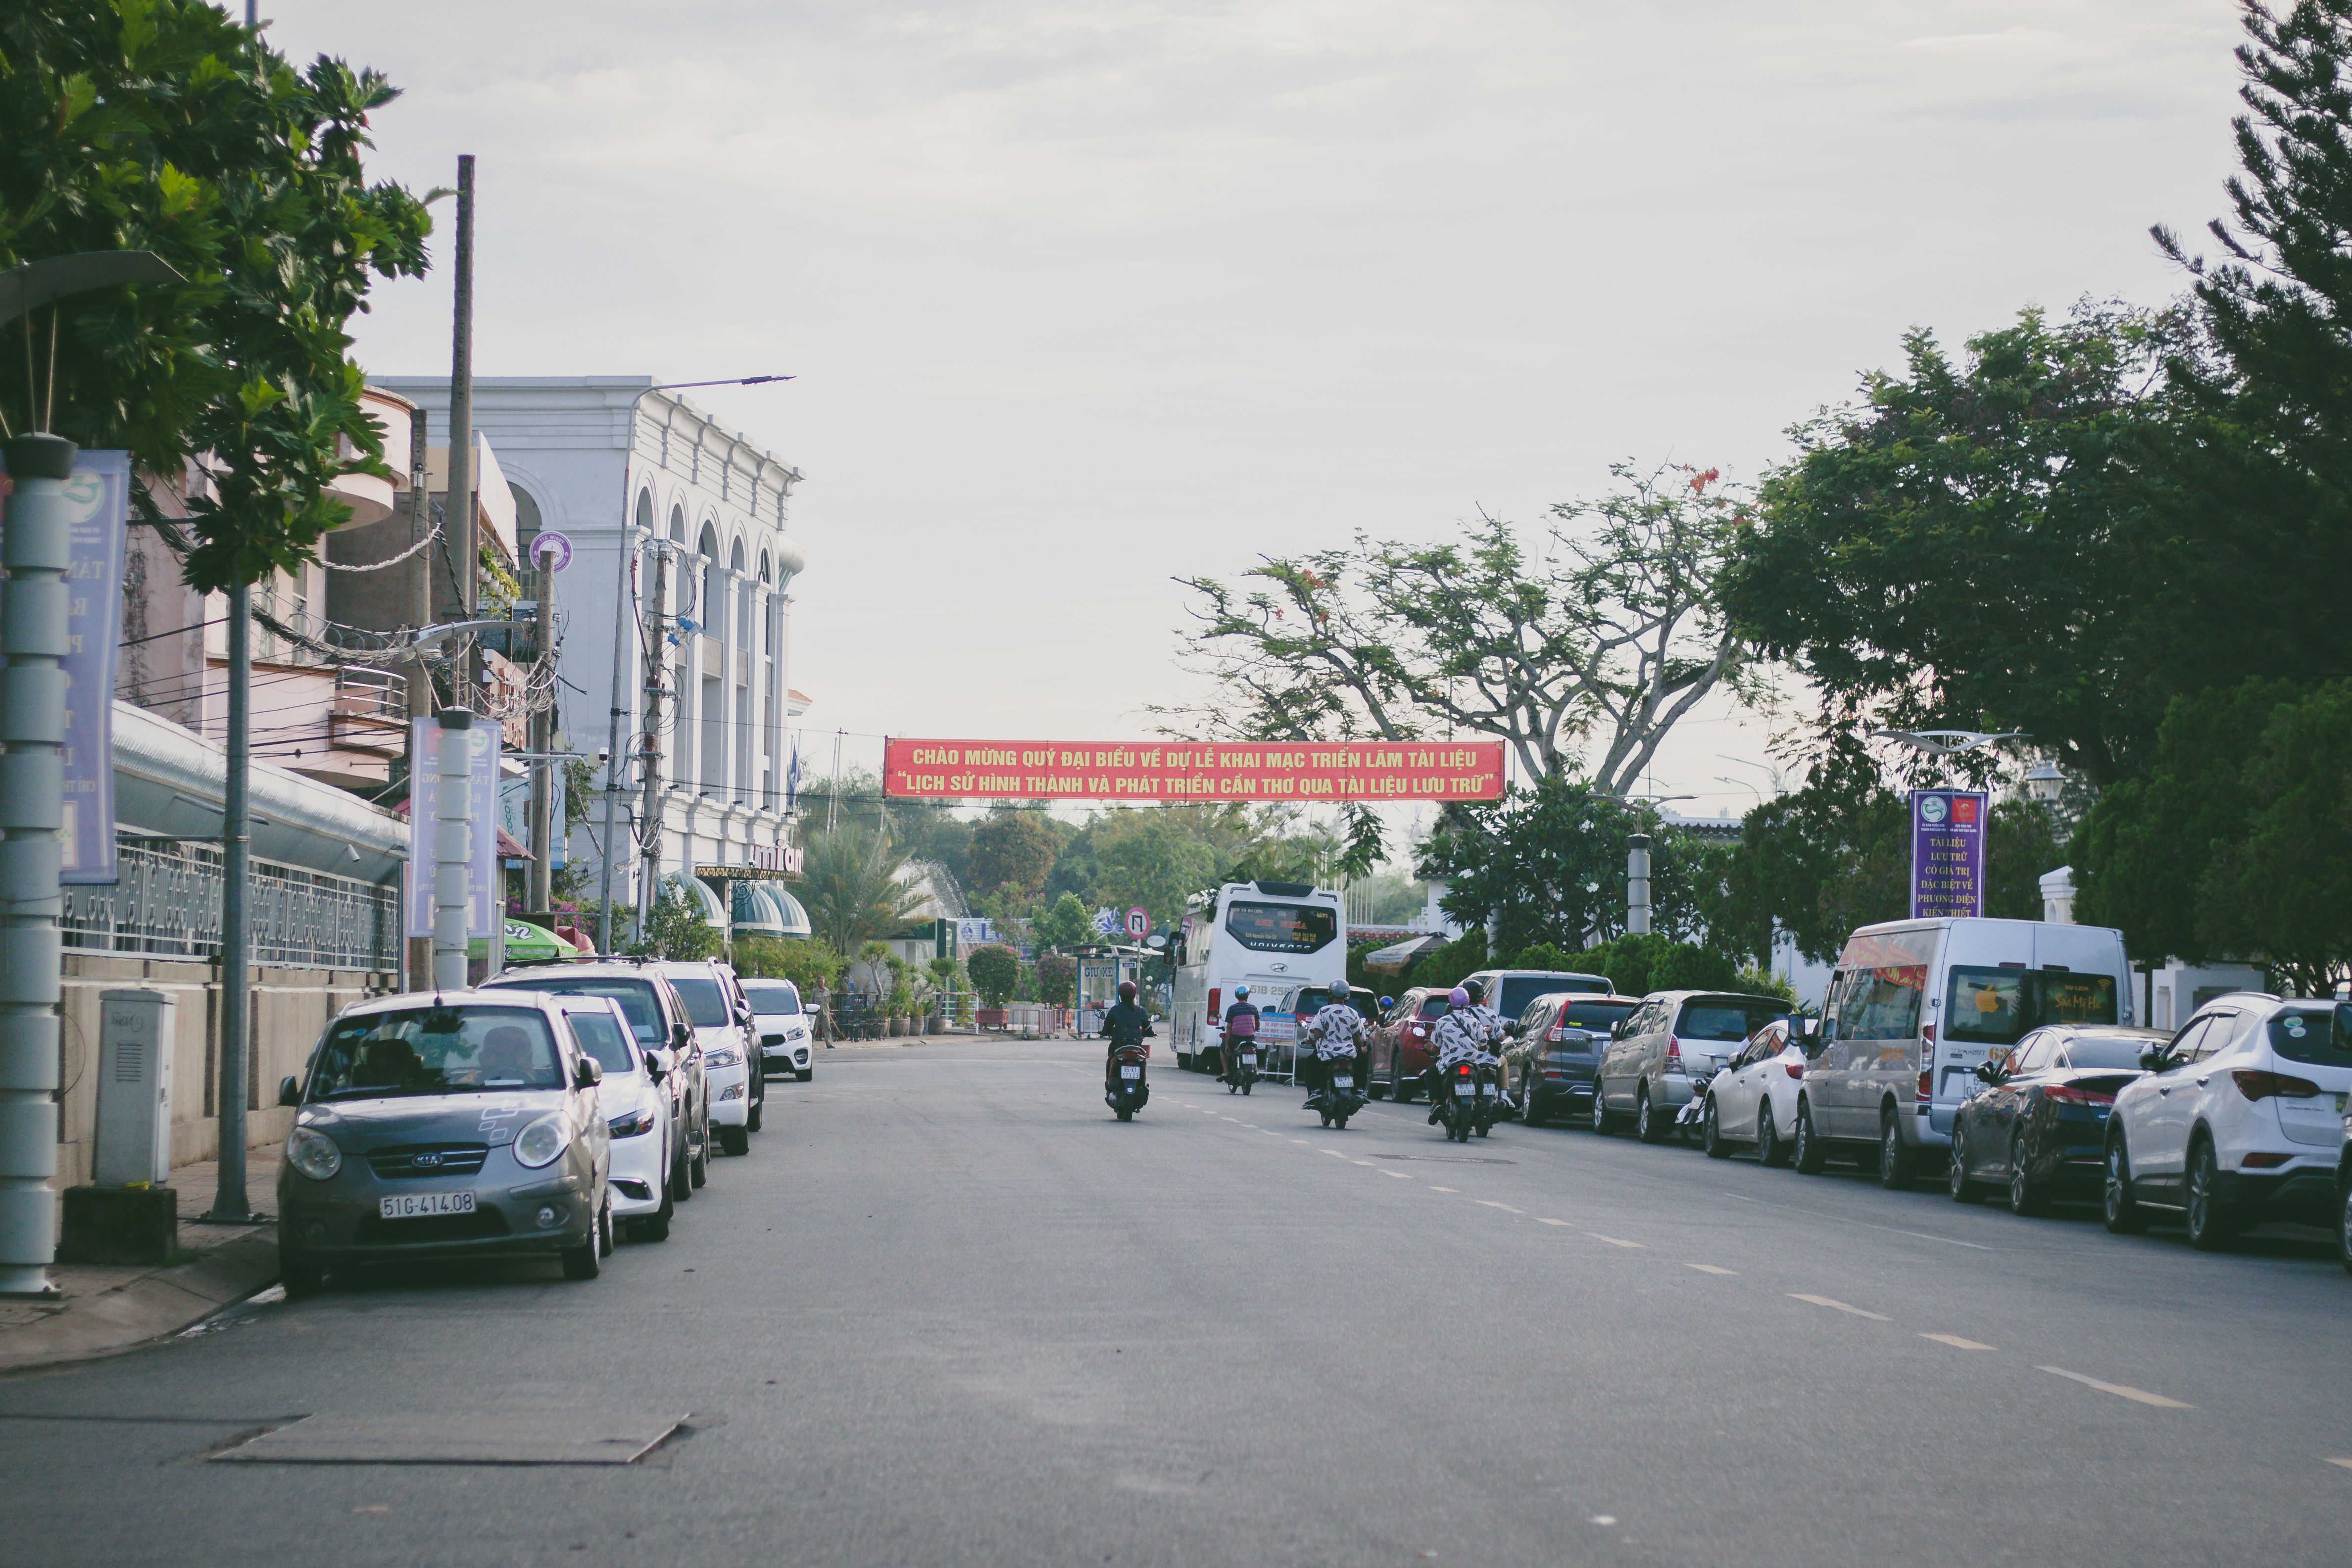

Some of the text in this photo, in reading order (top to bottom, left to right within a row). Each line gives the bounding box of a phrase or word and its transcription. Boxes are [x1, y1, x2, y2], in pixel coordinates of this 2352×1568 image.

[550, 535, 565, 544] WINDY
[913, 746, 1476, 771] CHÀO MỪNG QUÝ ĐẠI BIỂU VỀ DỰ LỄ KHAI MẠC TRIỂN LÃM TÀI LIỆU
[950, 771, 976, 791] SỬ
[979, 774, 1021, 792] HÌNH
[1026, 774, 1082, 792] THÀNH
[1088, 774, 1111, 793] VÀ
[1116, 774, 1161, 793] PHÁT
[1165, 772, 1215, 793] TRIỂN
[1221, 773, 1256, 793] CẦN
[1262, 777, 1296, 793] THƠ
[1299, 778, 1333, 795] QUA
[1338, 775, 1365, 794] TÀI
[1370, 775, 1407, 796] LIỆU
[1413, 777, 1447, 793] LƯU
[1930, 836, 1966, 849] TÀI LIỆU
[1931, 851, 1968, 861] LƯU TRỮ
[1925, 864, 1970, 878] CÓ GIÁ TRỊ
[1921, 878, 1973, 891] ĐẶC BIỆT VỀ
[1917, 893, 1976, 905] PHƯƠNG DIỆN
[1922, 906, 1971, 918] KIẾN THIẾT
[1102, 967, 1113, 977] XE
[1251, 984, 1268, 994] 51B
[1989, 1046, 2009, 1060] 63
[417, 1156, 438, 1164] KIA
[384, 1193, 473, 1216] 51G-414.08
